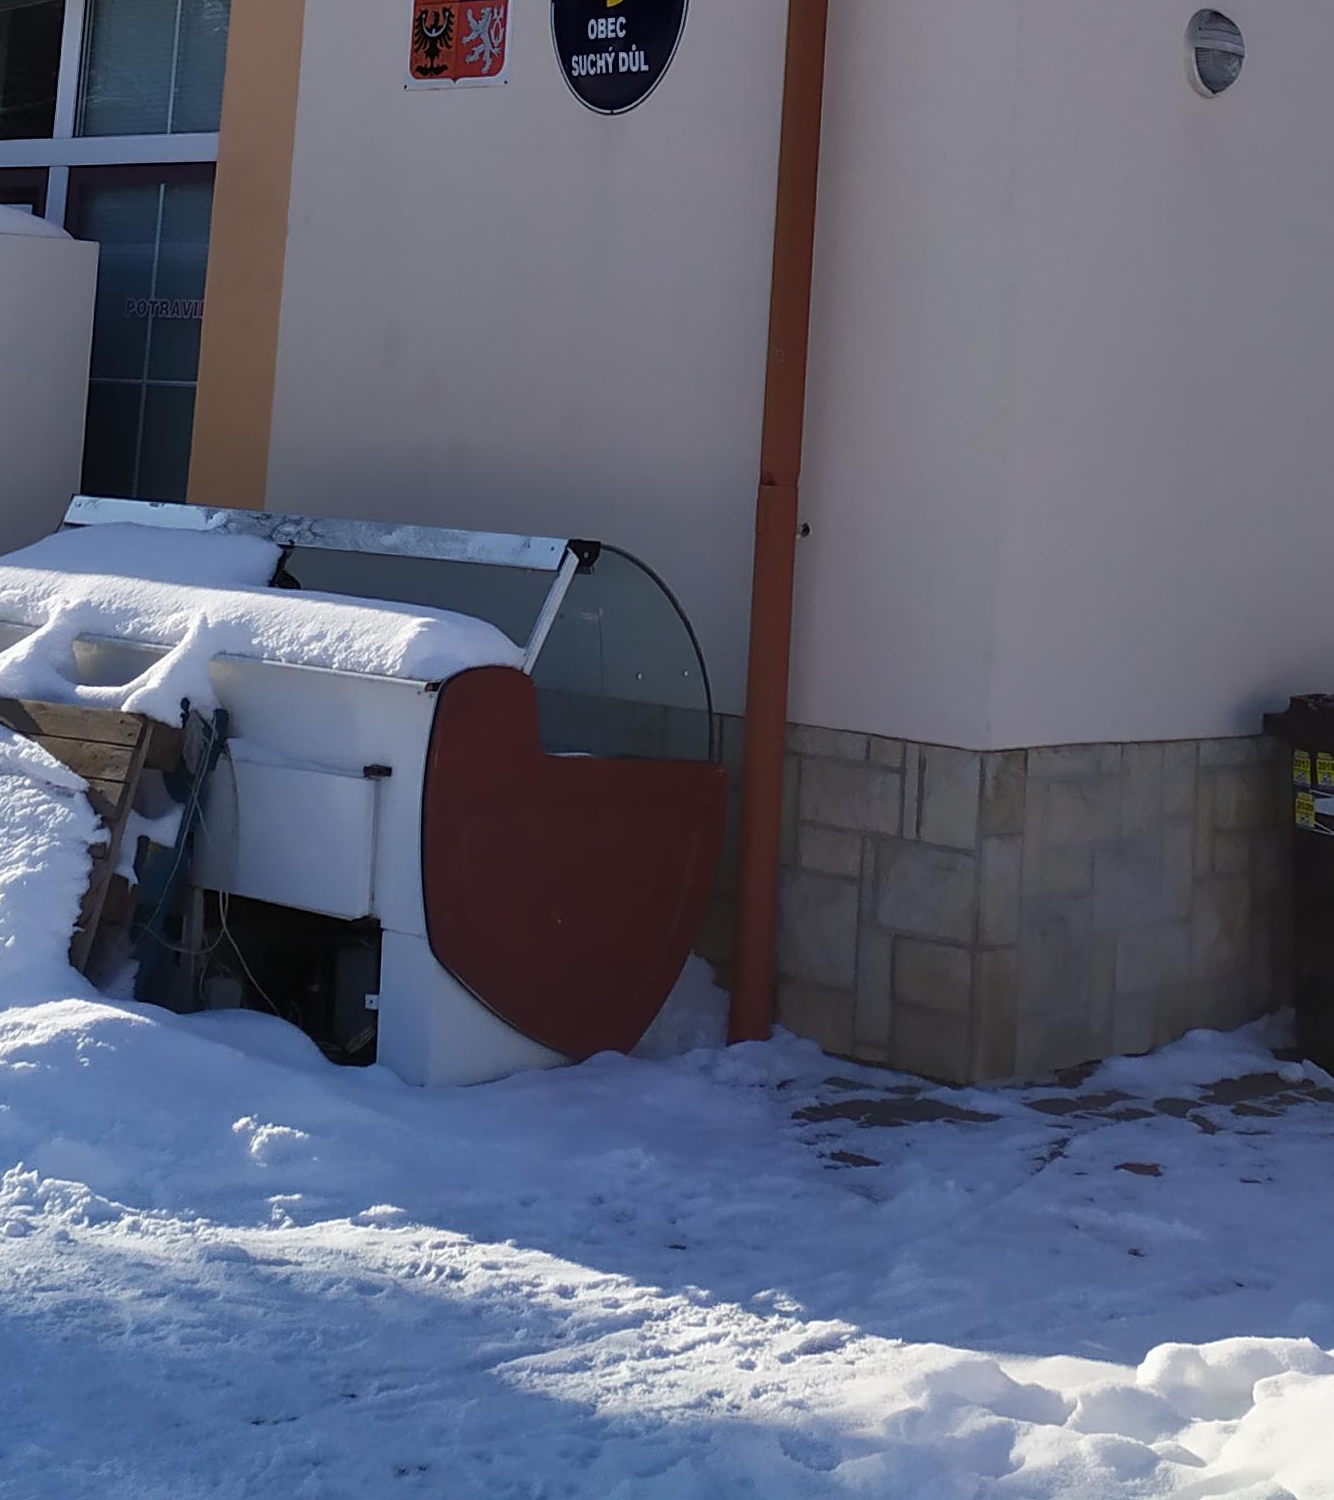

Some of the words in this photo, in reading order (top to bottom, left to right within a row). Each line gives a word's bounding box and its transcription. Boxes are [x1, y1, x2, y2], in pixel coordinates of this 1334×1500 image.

[587, 16, 627, 40] OBEC
[571, 46, 615, 77] SUCHÝ
[618, 43, 649, 73] DŮL
